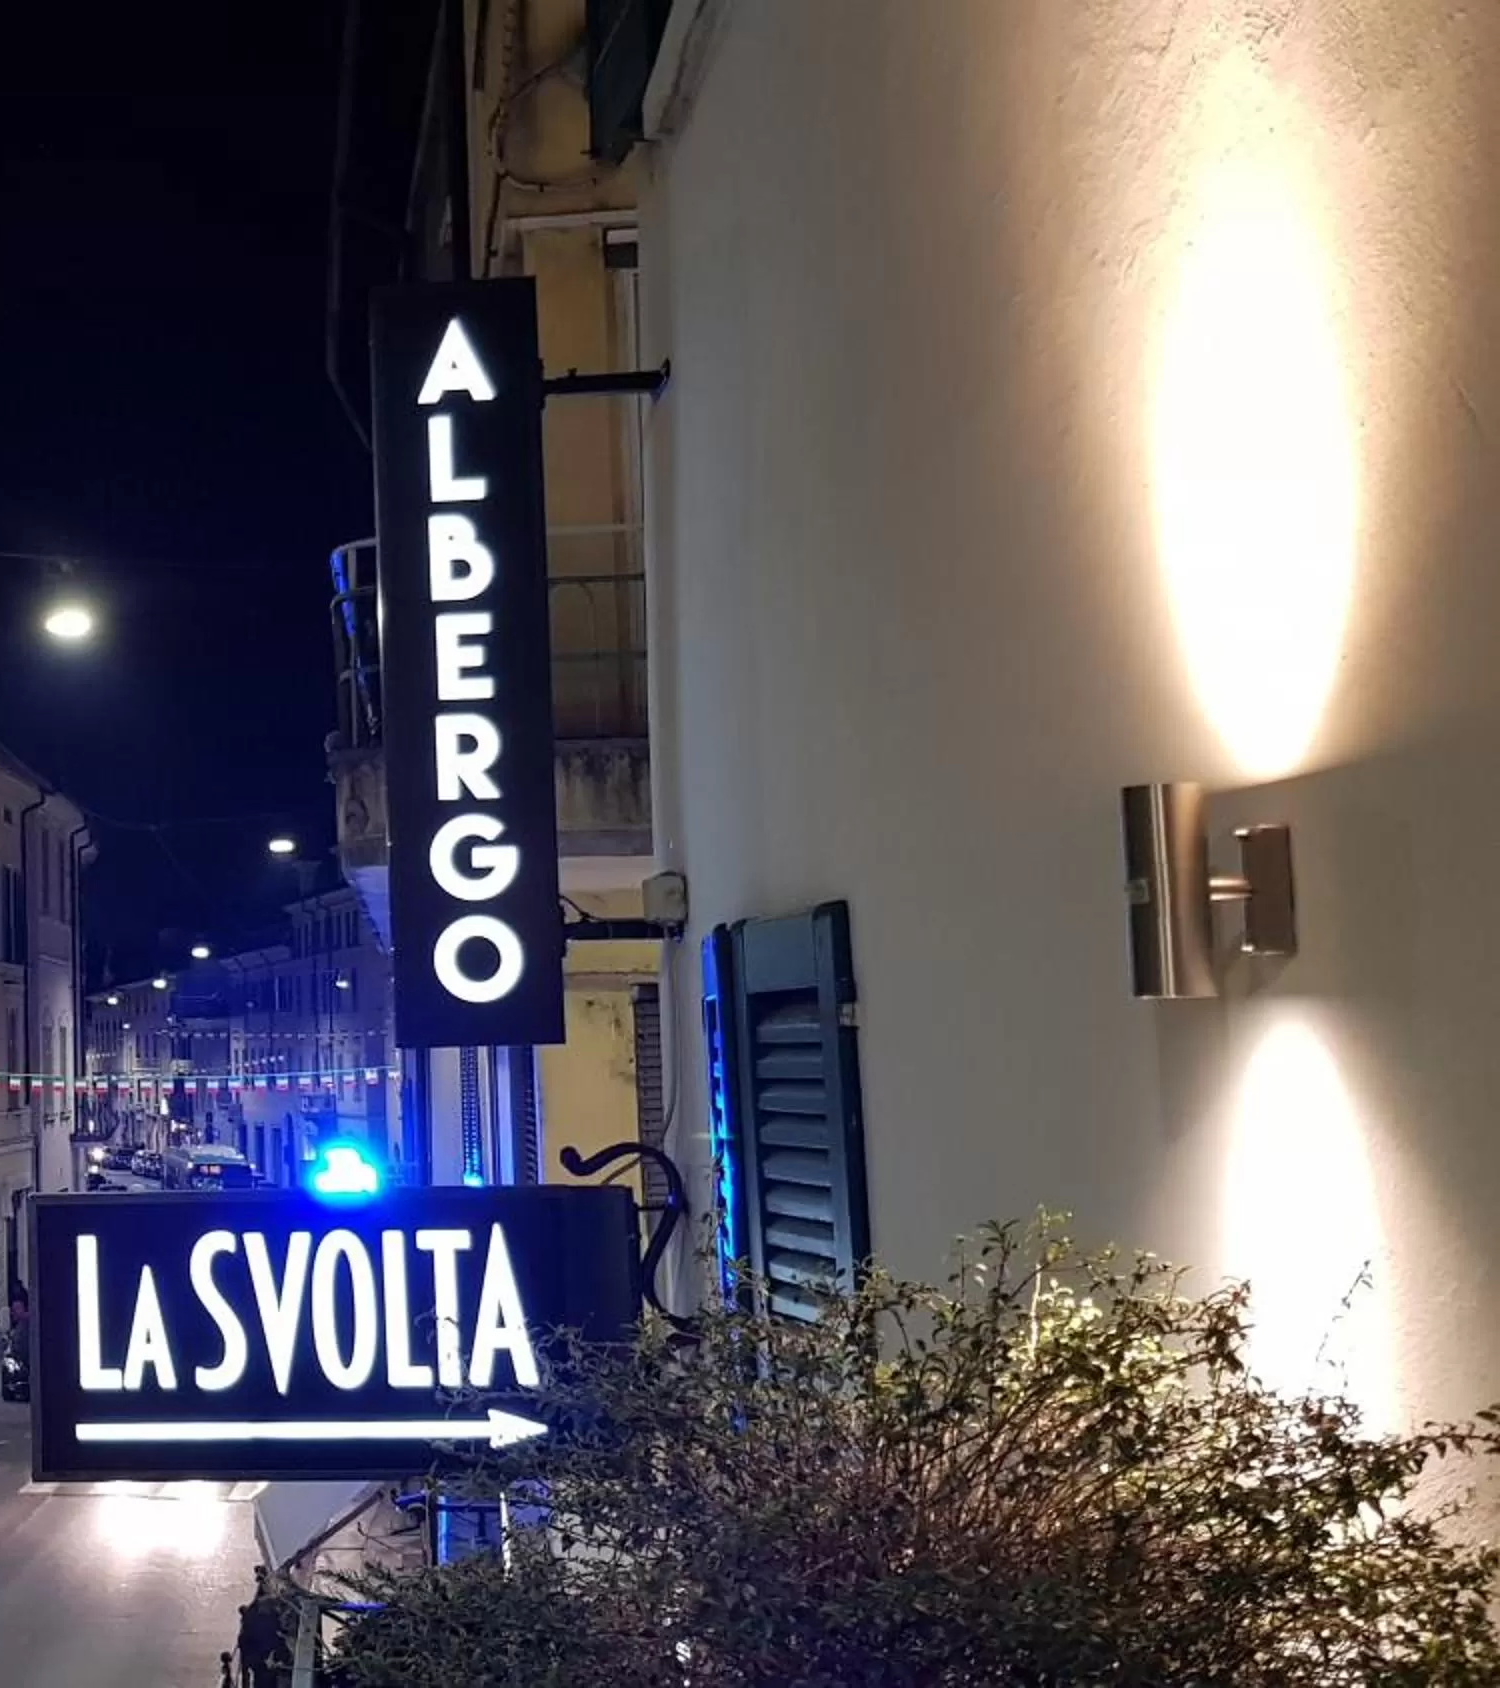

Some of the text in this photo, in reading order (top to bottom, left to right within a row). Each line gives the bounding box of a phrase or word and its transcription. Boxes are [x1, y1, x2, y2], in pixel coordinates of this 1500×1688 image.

[416, 317, 524, 1004] ALBERGO
[76, 1222, 541, 1395] LA SVOLTA
